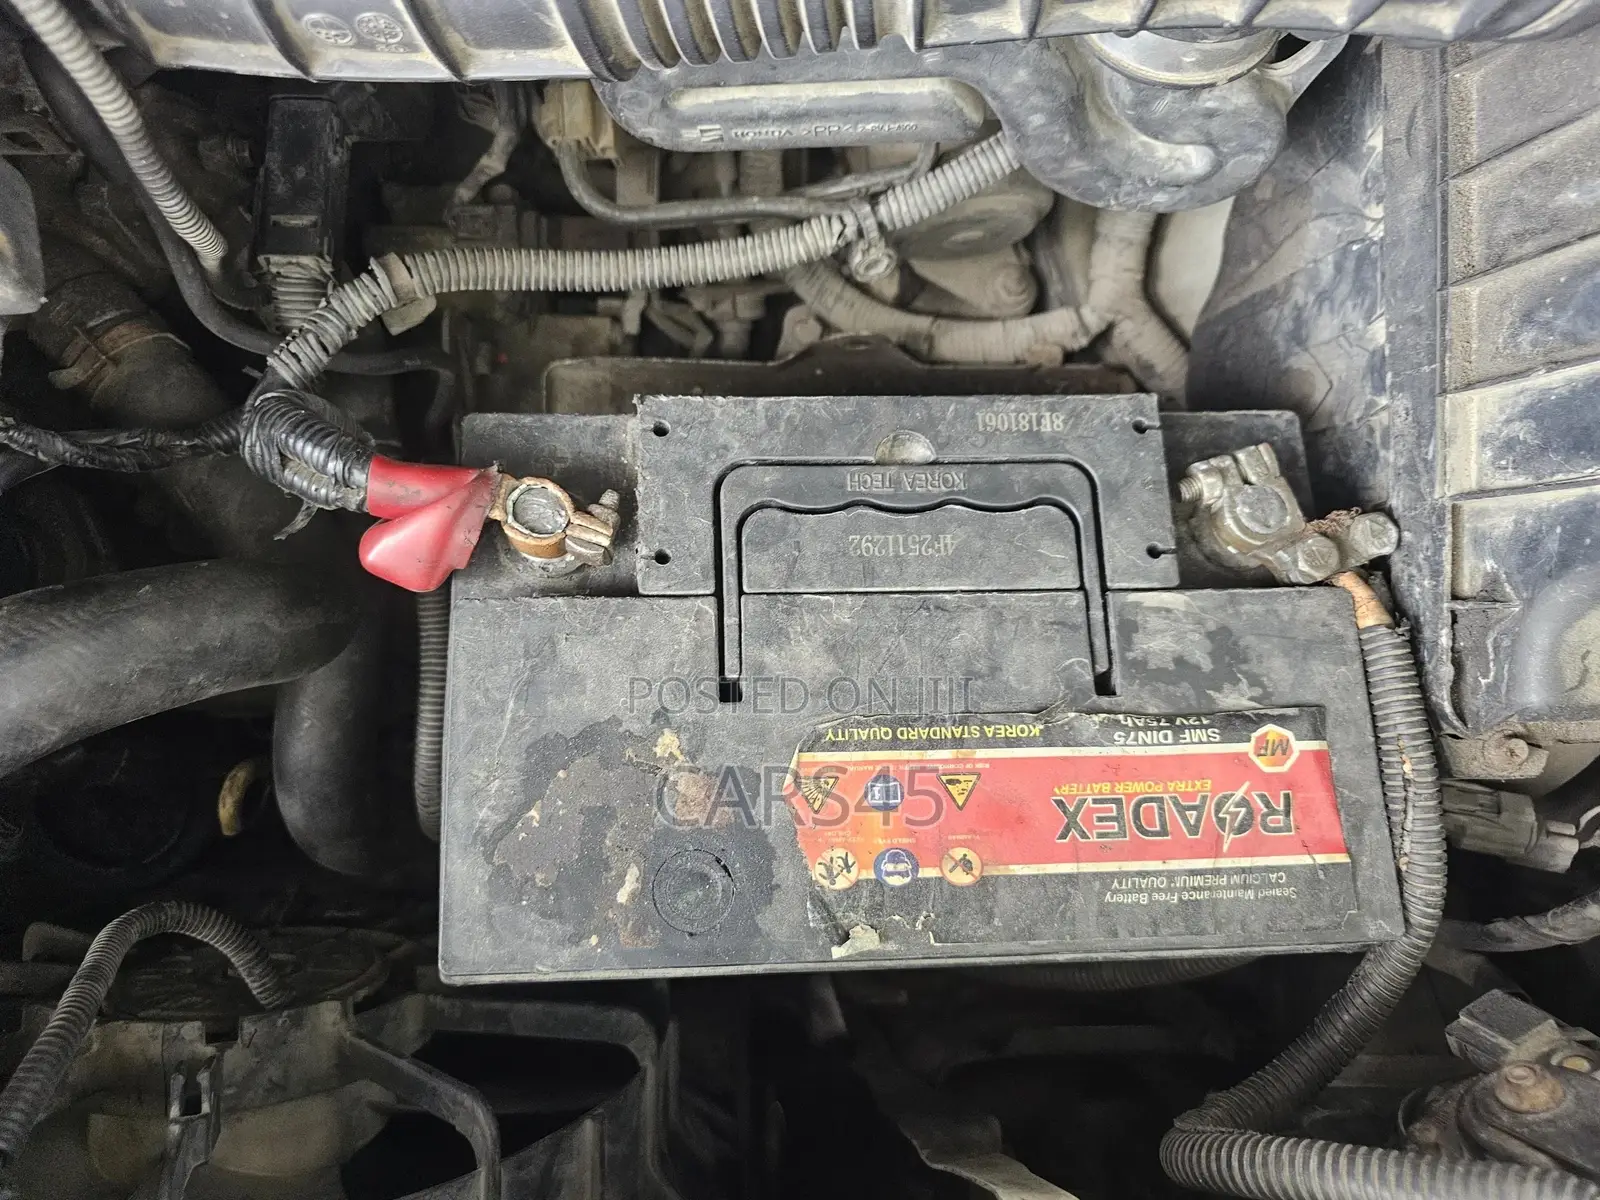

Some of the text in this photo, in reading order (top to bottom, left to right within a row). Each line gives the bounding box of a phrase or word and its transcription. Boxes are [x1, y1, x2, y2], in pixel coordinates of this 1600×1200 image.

[847, 470, 967, 491] KOREA TECH
[848, 533, 960, 557] 4F2511292
[826, 724, 1041, 741] KOREA STANDARD QUALITY
[1113, 728, 1221, 746] SMF DIN75
[1257, 738, 1290, 757] MF
[1114, 780, 1164, 793] POWER
[1167, 779, 1212, 792] EXTRA
[1050, 790, 1295, 842] ROADEX
[1230, 872, 1286, 884] CALCIUM
[1104, 891, 1148, 905] Battery
[1152, 891, 1177, 903] Free
